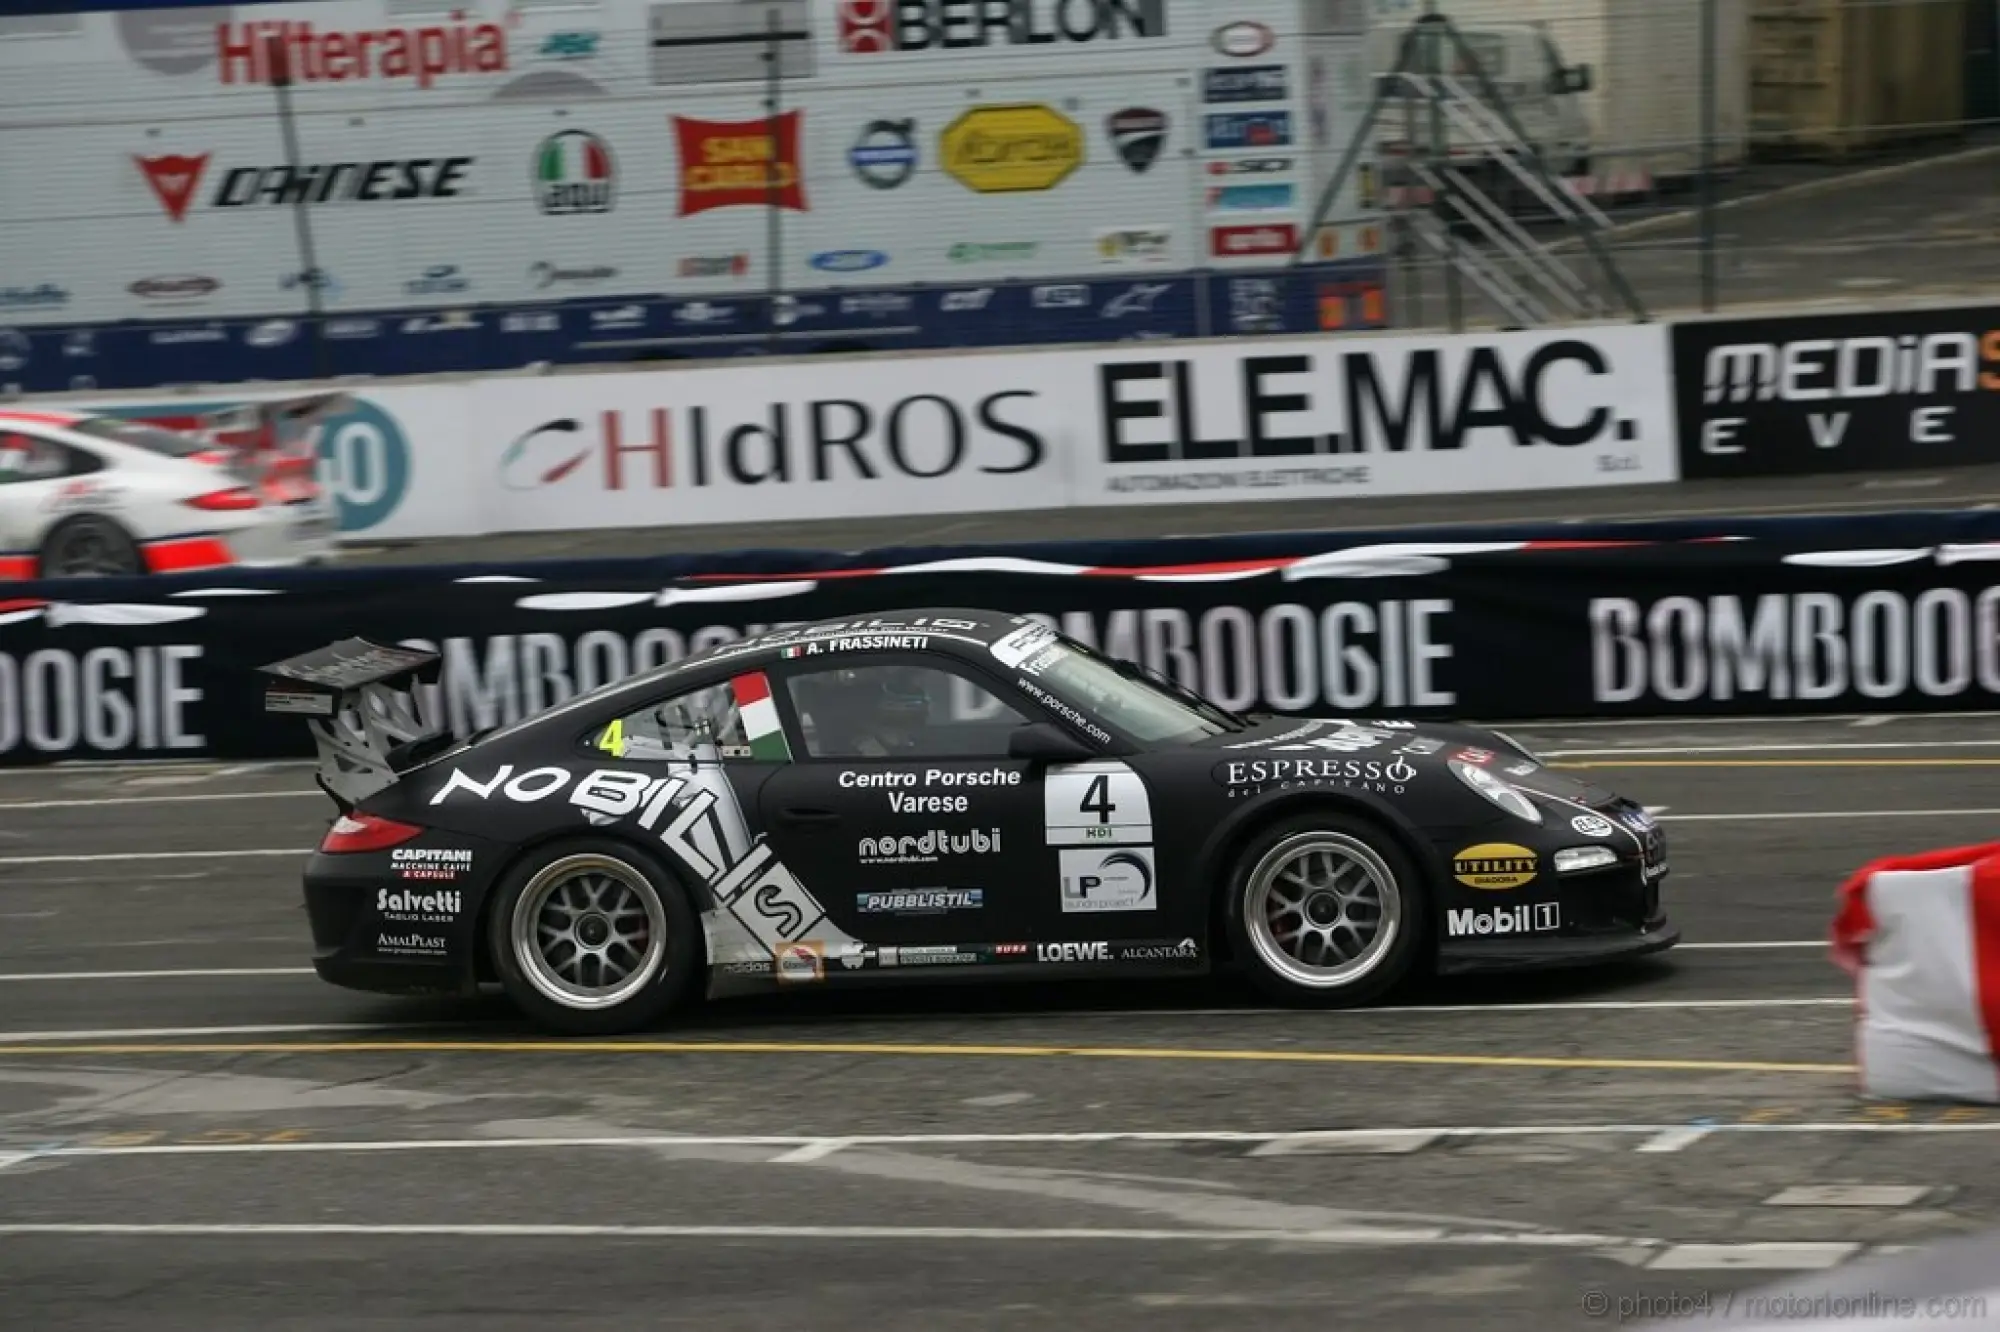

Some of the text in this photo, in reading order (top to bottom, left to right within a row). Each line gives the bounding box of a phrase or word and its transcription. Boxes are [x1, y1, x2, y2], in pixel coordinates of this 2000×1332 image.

[806, 634, 930, 656] A. FRASSINETI
[1018, 677, 1112, 745] www.porsche.com
[598, 718, 625, 758] 4
[838, 767, 1022, 789] Centro Porsche
[888, 791, 969, 814] Varese
[1079, 773, 1117, 824] 4
[858, 827, 1002, 856] nordtubi
[391, 848, 473, 862] CAPITANI
[1454, 859, 1537, 872] UTILITY
[1063, 876, 1102, 899] LP
[376, 887, 462, 912] Salvetti
[867, 890, 974, 910] PUBBLISTIL
[1446, 904, 1531, 937] Mobil
[1120, 945, 1200, 959] ALCANTARA
